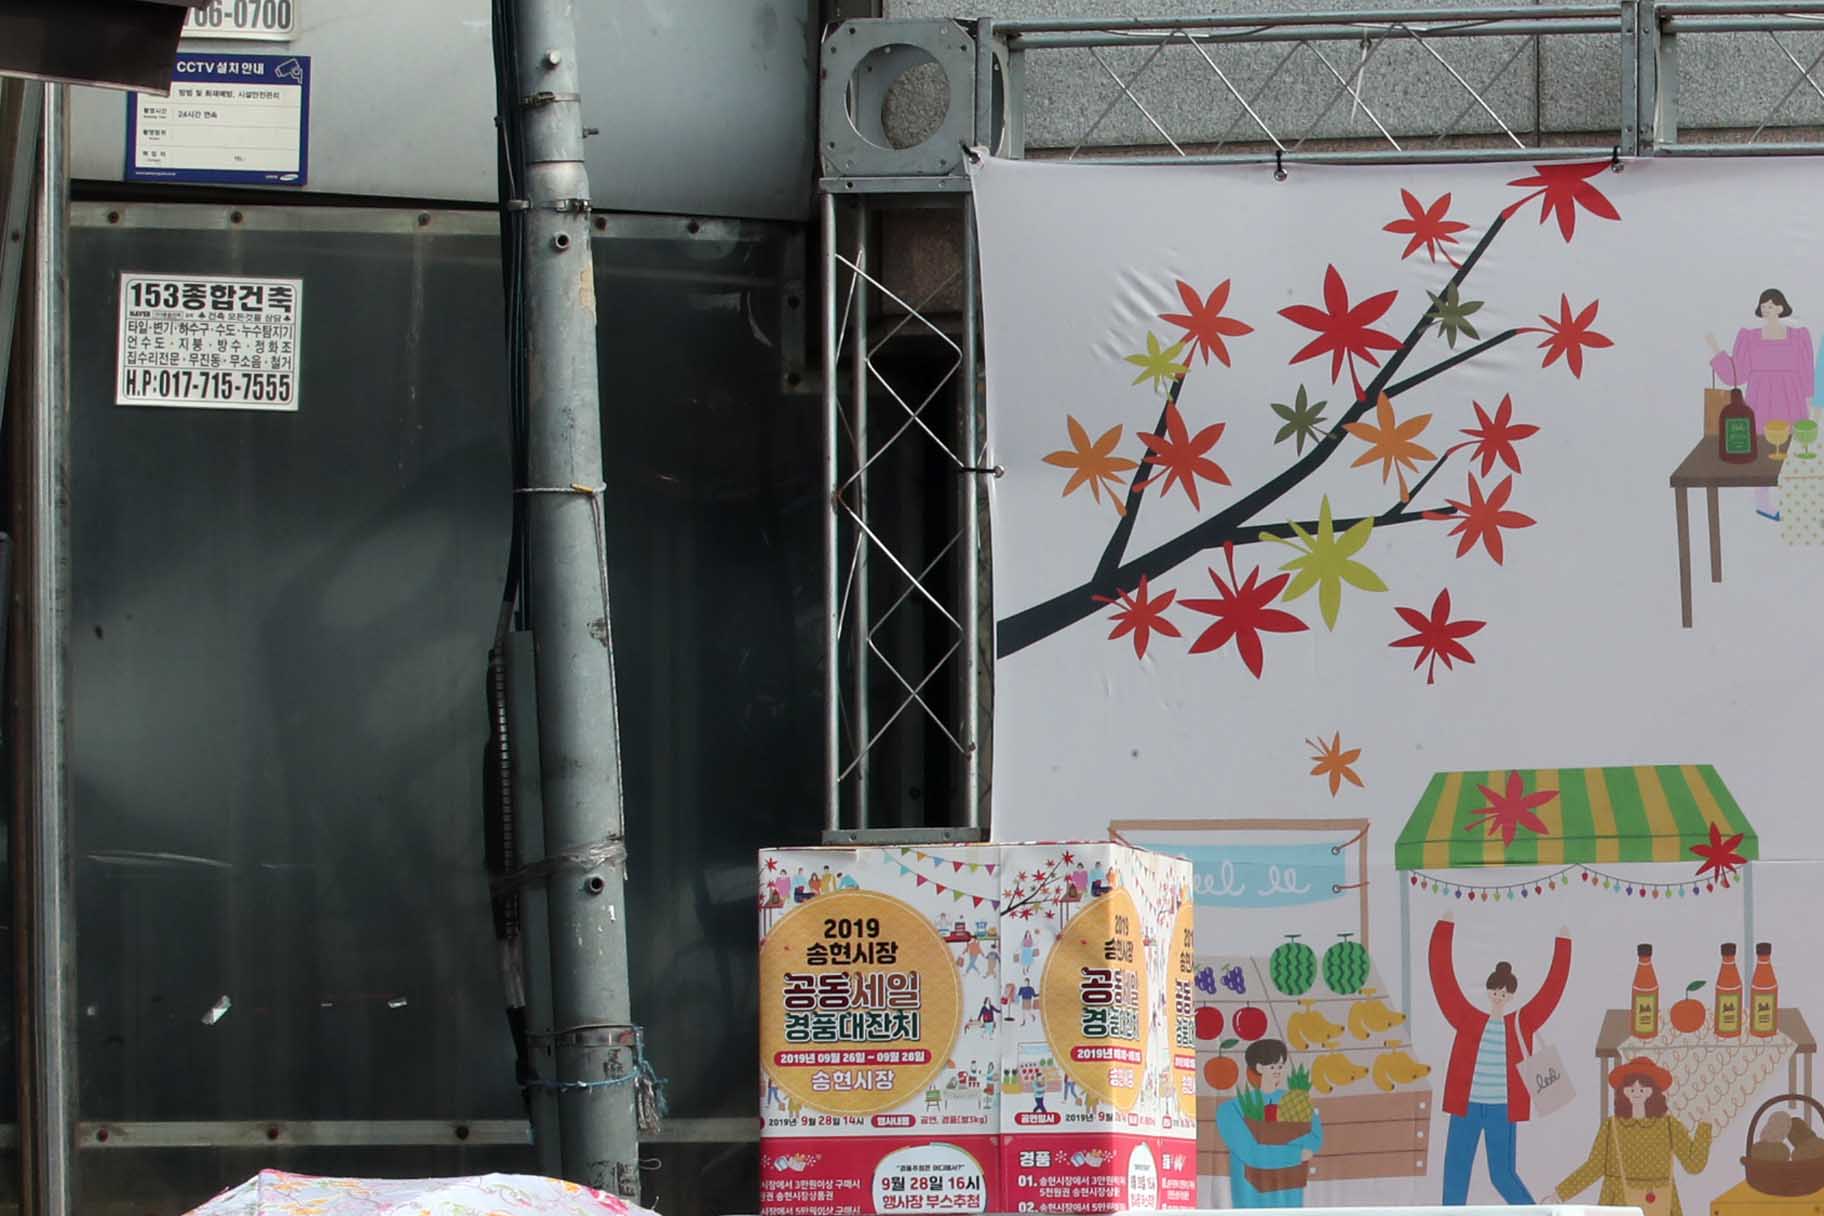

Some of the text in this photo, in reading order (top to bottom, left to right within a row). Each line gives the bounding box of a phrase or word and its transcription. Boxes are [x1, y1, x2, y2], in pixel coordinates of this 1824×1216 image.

[176, 61, 265, 75] CCTV 설치 안내
[131, 283, 293, 312] 153종합건축
[824, 918, 881, 939] 2019
[806, 941, 899, 966] 송현시장
[783, 970, 922, 1011] 공동세일
[784, 1012, 922, 1043] 경품대잔치
[780, 1053, 816, 1064] 2019년
[817, 1052, 841, 1063] 09월
[843, 1052, 865, 1063] 26일
[877, 1051, 901, 1062] 09월
[902, 1050, 925, 1062] 28일
[811, 1069, 896, 1092] 송현시장
[1018, 1150, 1052, 1168] 경품
[881, 1175, 980, 1191] 9월 28일 16시
[1018, 1175, 1038, 1187] 01.
[882, 1194, 980, 1209] 행사장 부스추첨
